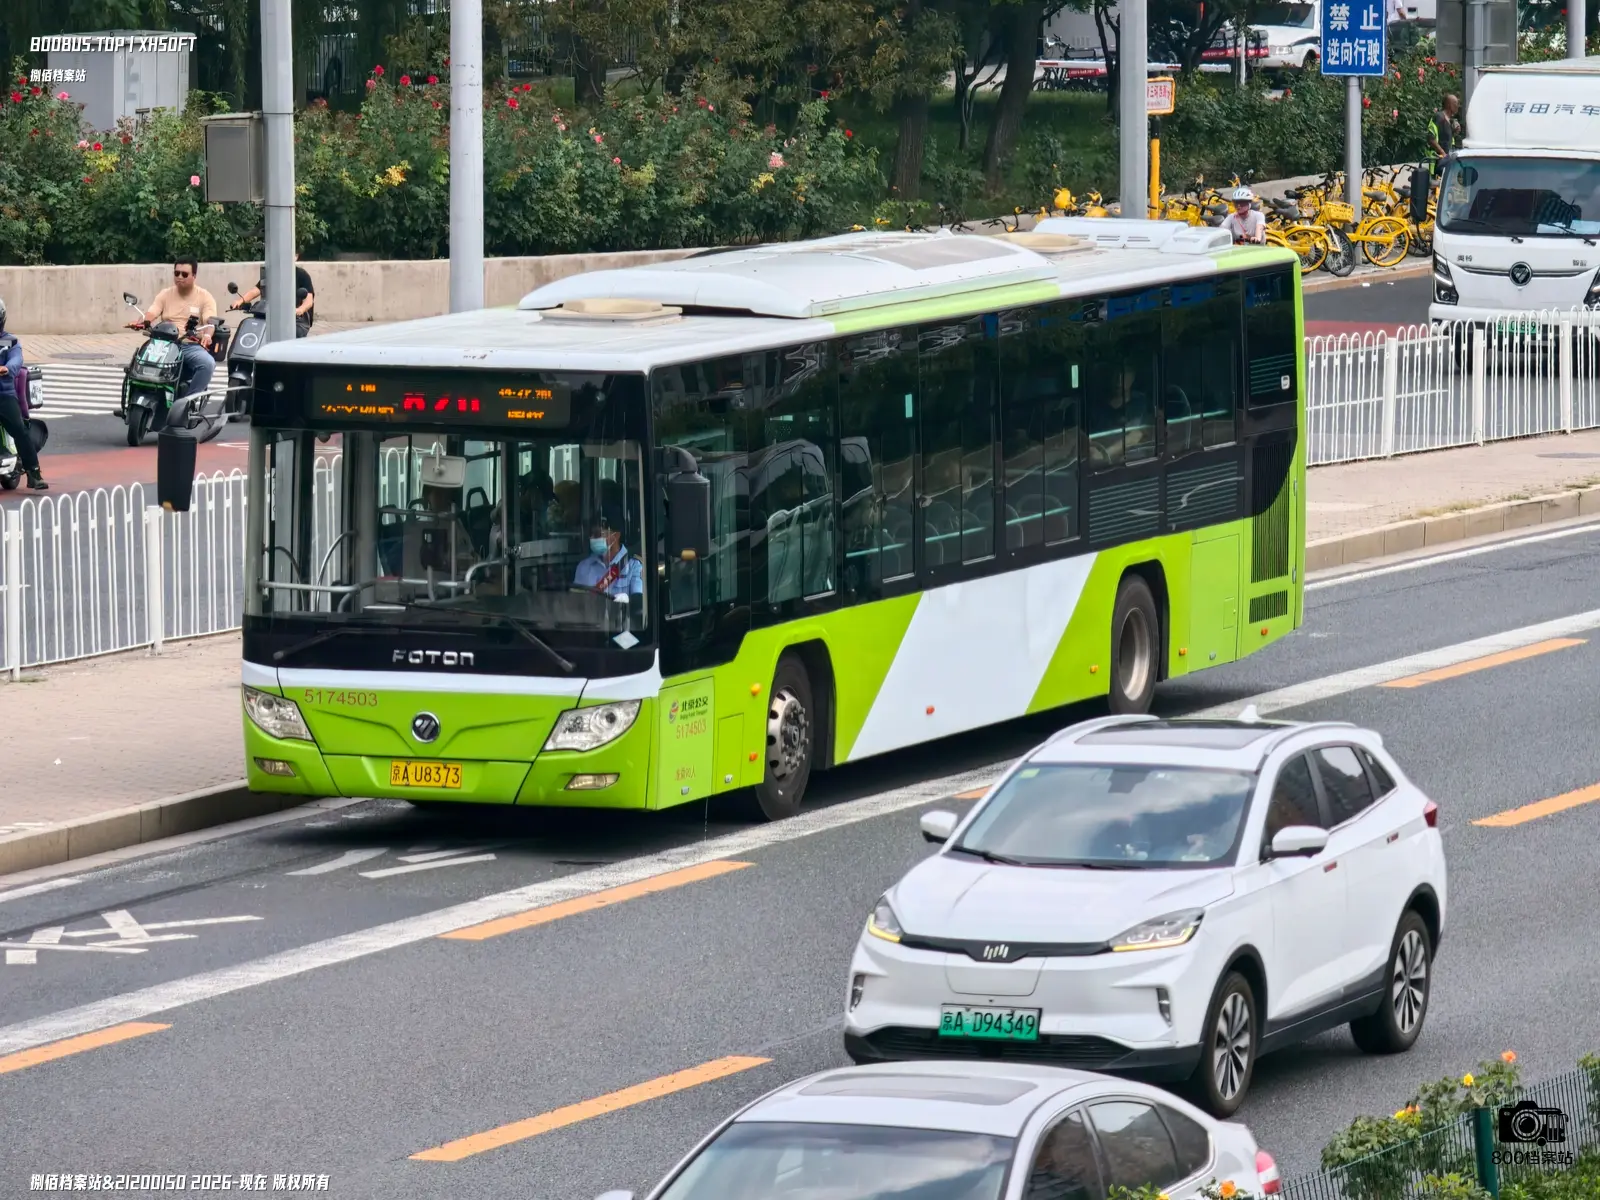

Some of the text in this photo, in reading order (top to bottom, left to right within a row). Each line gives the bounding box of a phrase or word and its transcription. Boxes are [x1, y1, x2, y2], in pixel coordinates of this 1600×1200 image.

[1329, 3, 1381, 31] 禁止
[1327, 38, 1380, 67] 逆向行驶
[1504, 102, 1600, 116] 福田汽车
[392, 649, 475, 666] FOTON
[304, 689, 378, 707] 5174503
[676, 718, 707, 740] 5174503
